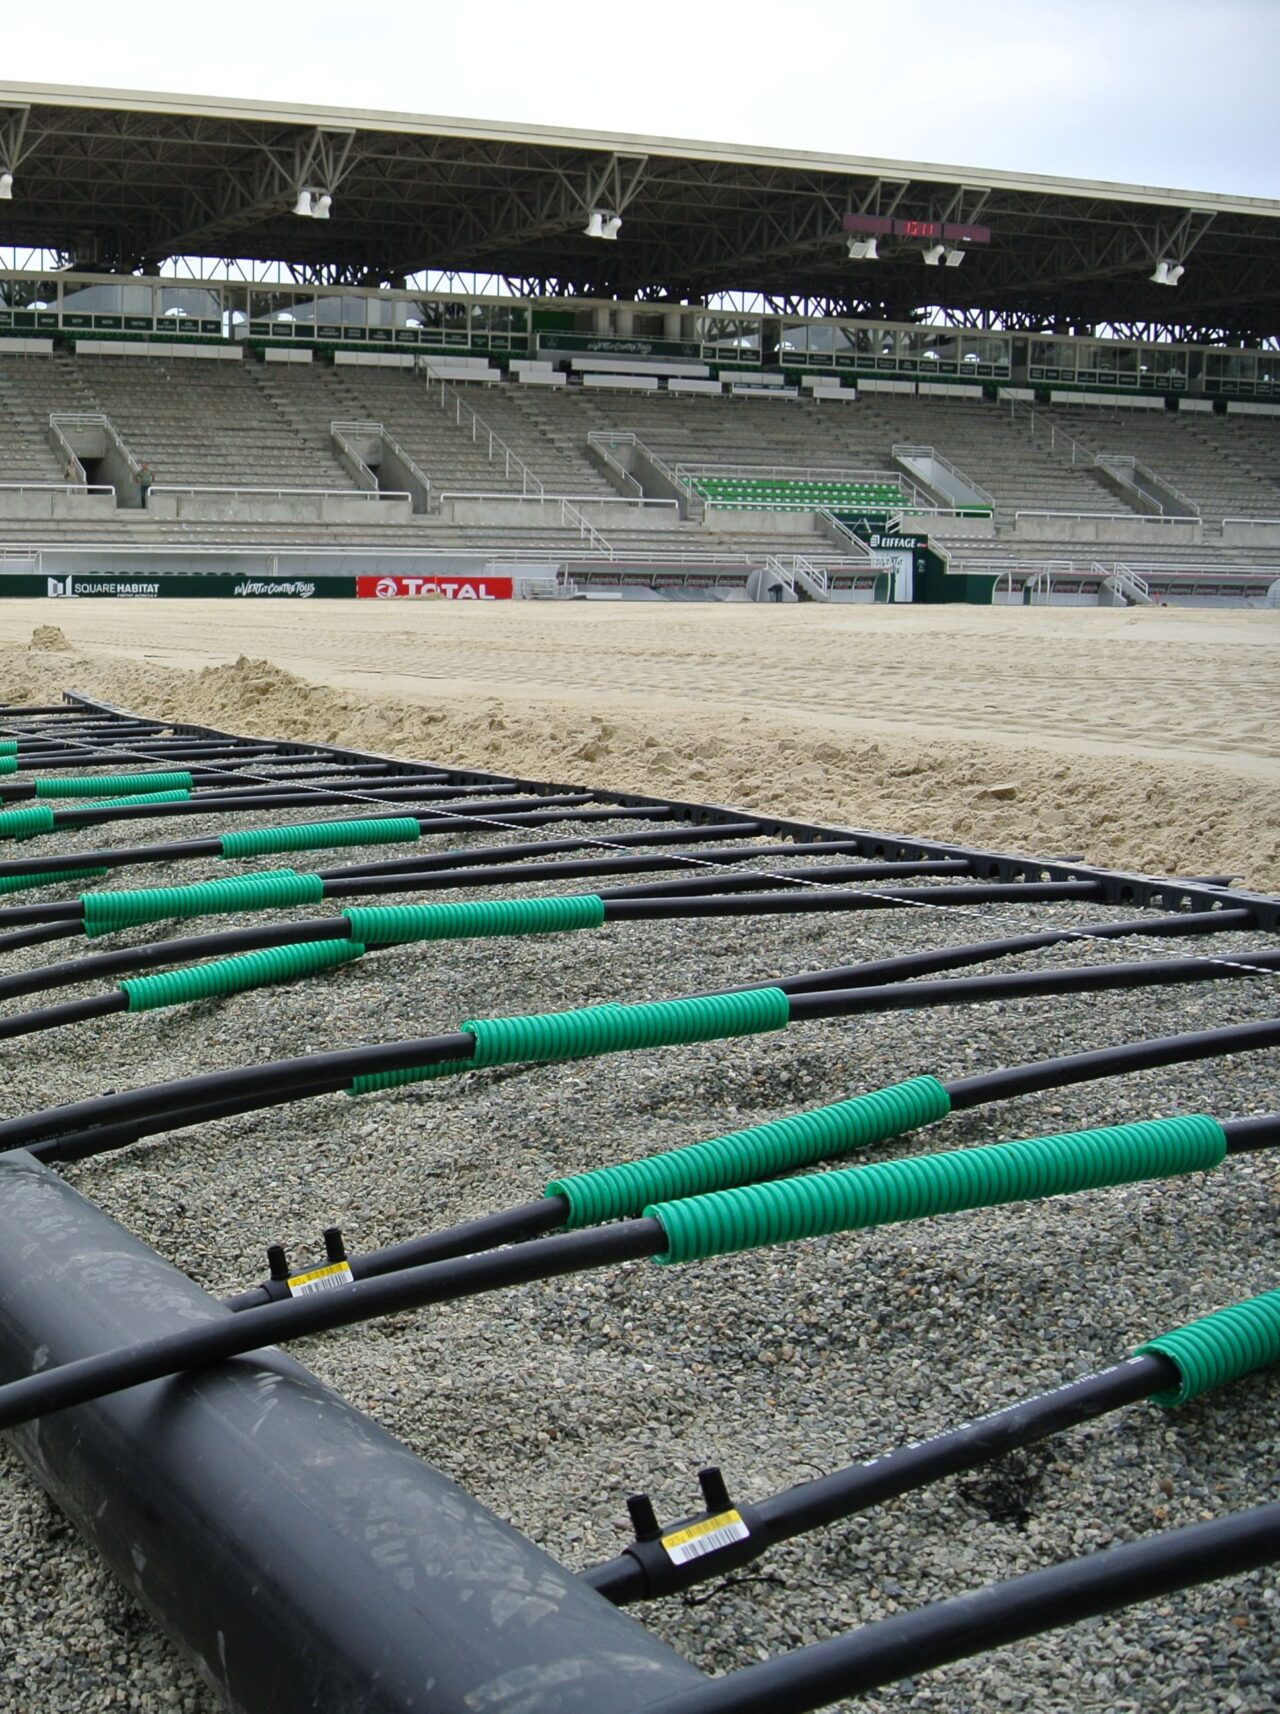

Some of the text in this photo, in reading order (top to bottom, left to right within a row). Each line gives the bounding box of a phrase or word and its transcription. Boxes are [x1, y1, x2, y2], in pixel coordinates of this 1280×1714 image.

[881, 538, 916, 548] EIFFAGE
[74, 583, 160, 594] SQUARE HABITAT
[402, 579, 496, 600] TOTAL
